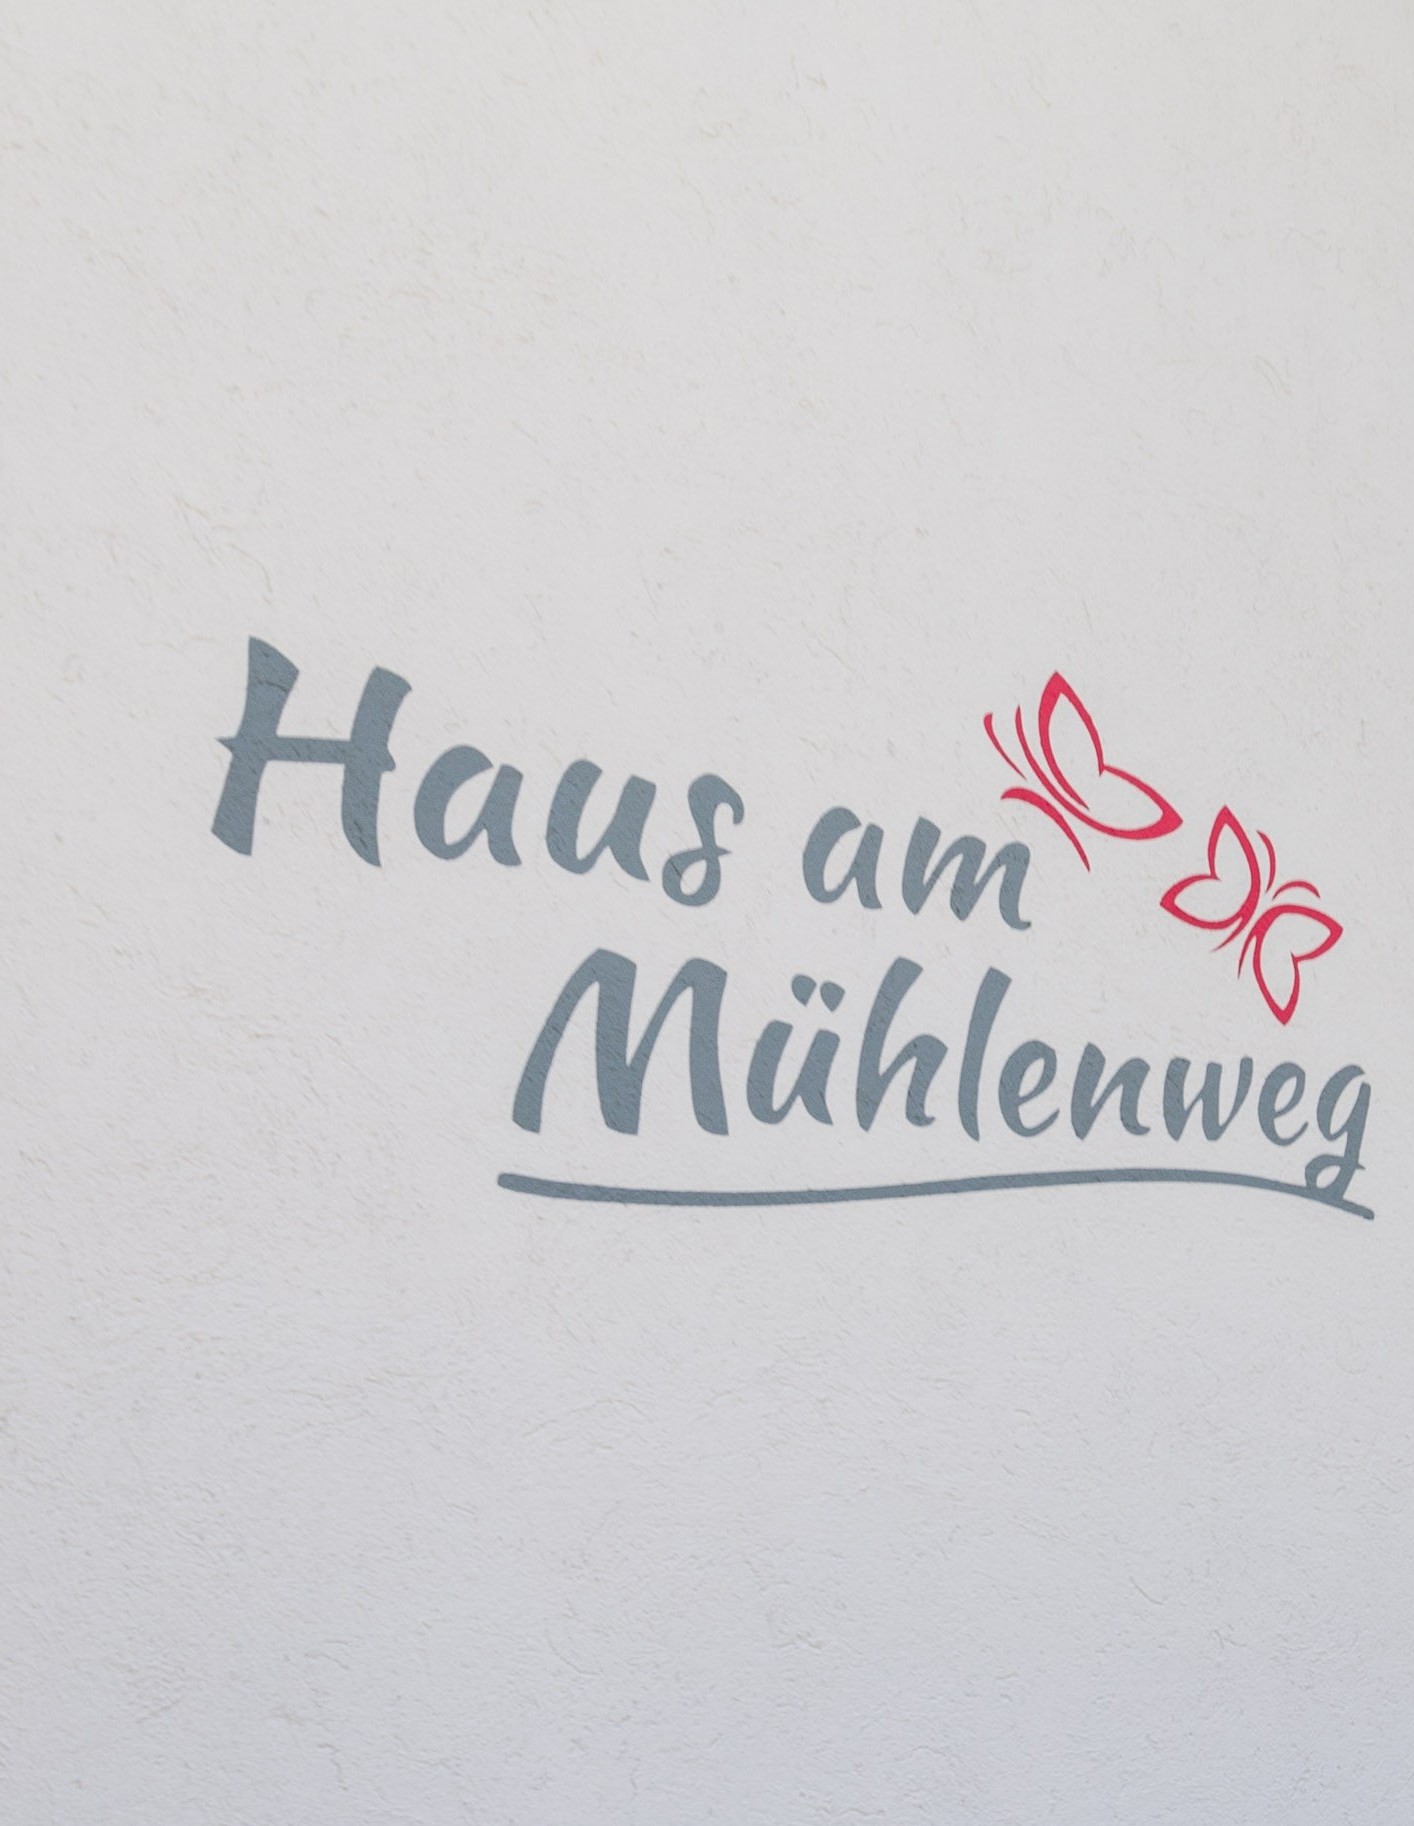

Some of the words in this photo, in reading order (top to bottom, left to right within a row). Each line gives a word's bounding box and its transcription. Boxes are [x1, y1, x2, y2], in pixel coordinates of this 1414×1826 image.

[210, 636, 745, 908] Haus
[802, 806, 1032, 931] am
[511, 947, 1372, 1197] Mühlenweg
